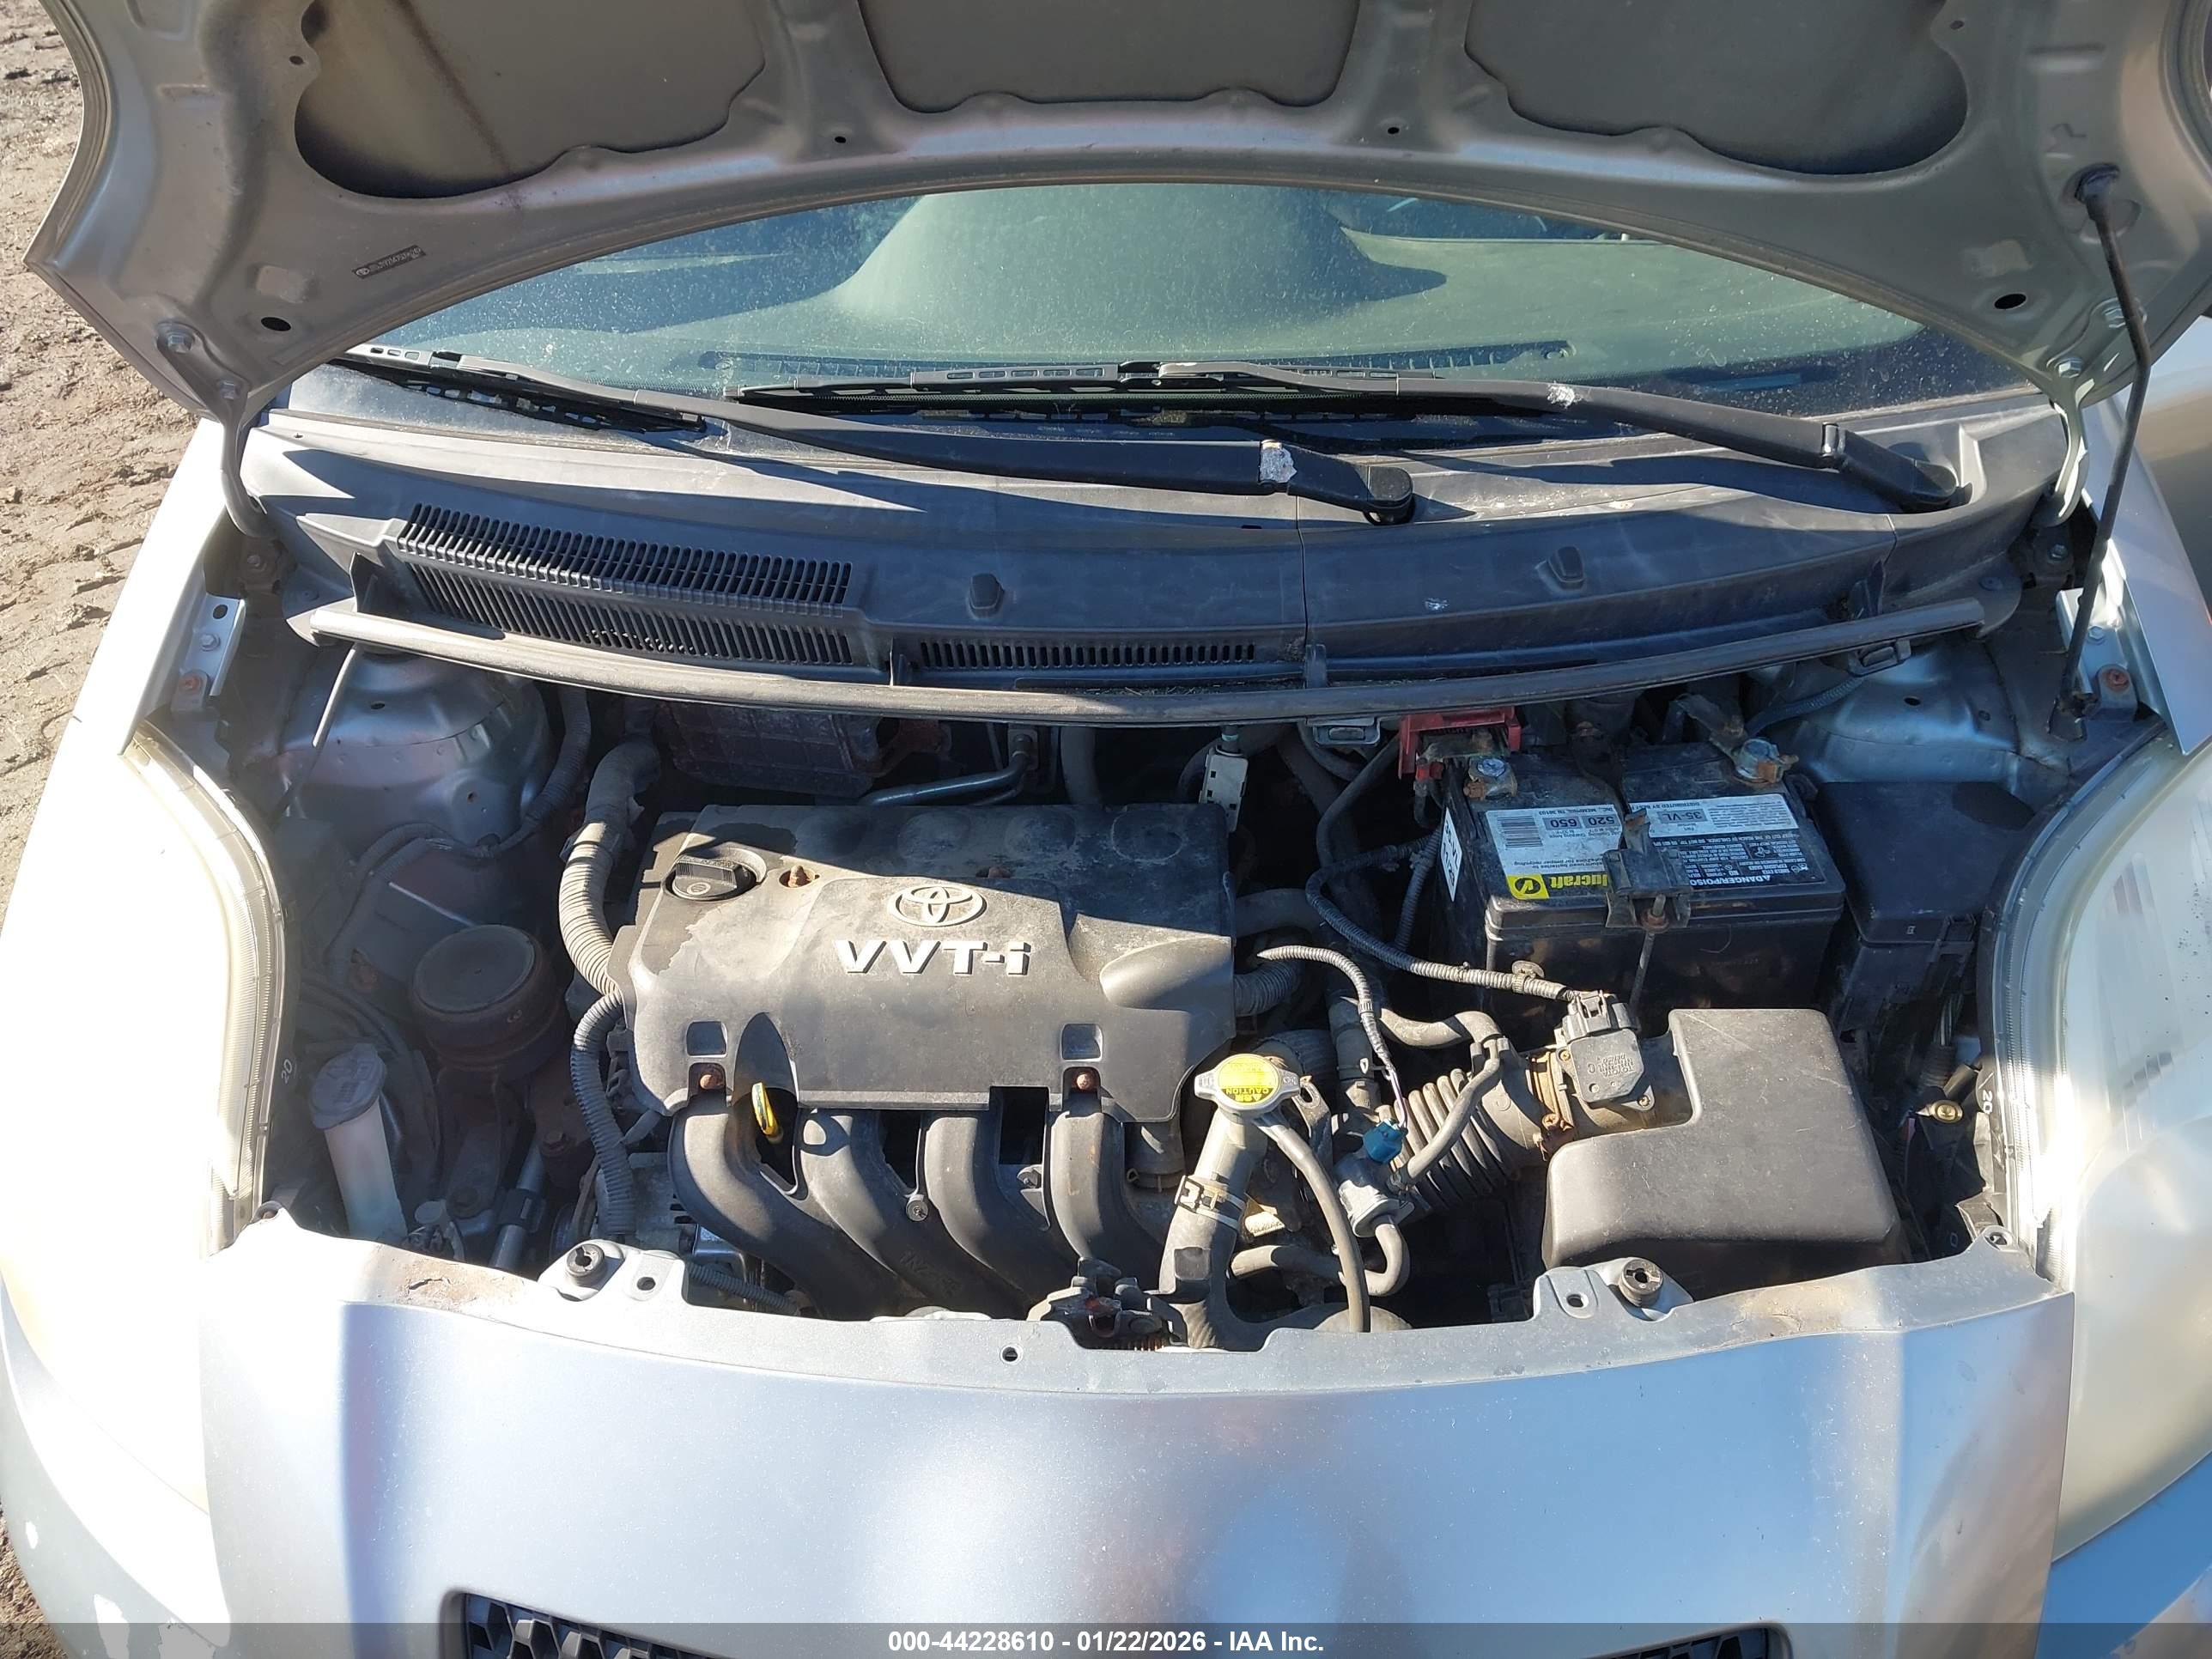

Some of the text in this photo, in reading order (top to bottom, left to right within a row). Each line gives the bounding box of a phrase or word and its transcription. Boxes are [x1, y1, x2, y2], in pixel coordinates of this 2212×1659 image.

[1588, 817, 1615, 826] 520
[1662, 811, 1702, 822] 35-VL
[1550, 818, 1577, 828] 650
[835, 939, 1031, 975] VVT-i
